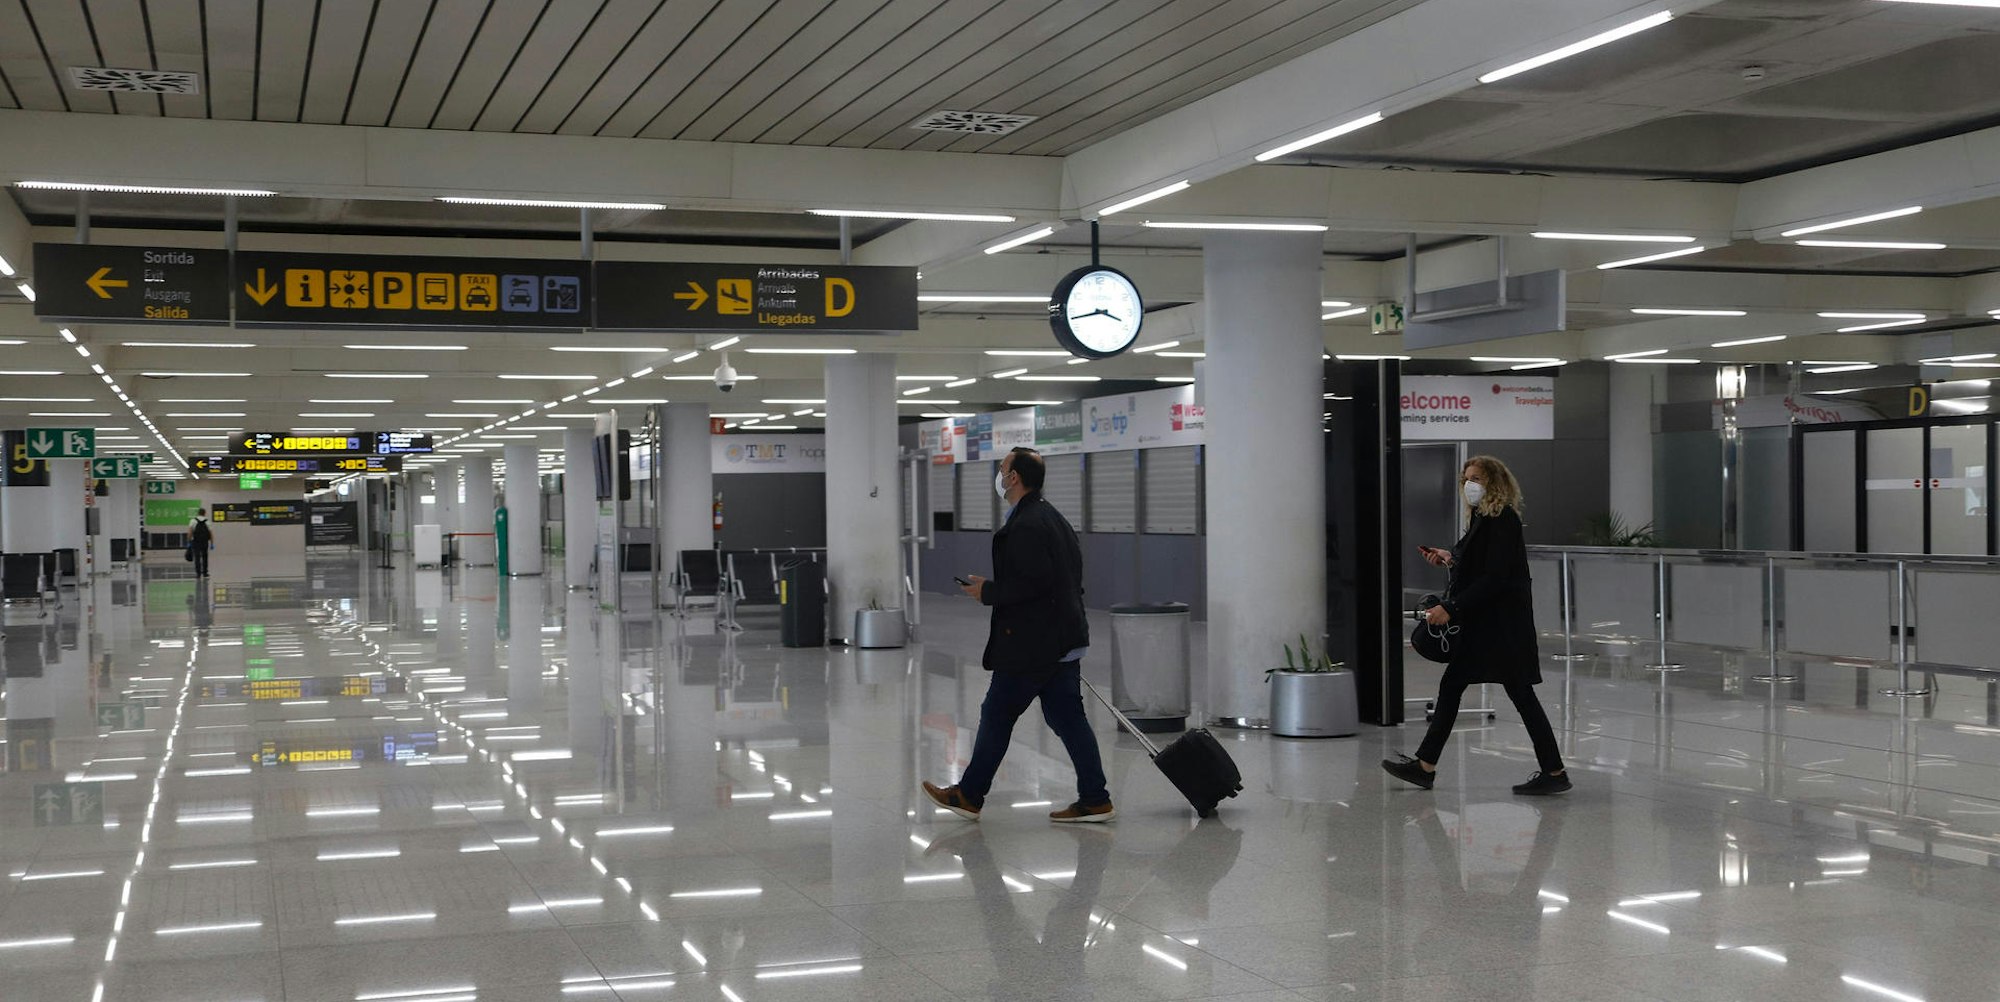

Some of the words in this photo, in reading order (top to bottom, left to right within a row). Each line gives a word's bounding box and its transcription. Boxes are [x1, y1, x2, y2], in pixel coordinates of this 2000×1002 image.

[144, 251, 194, 264] Sortida
[467, 276, 490, 284] TAXI
[758, 268, 820, 279] Arribades
[1095, 276, 1104, 285] 12
[144, 287, 191, 303] Ausgang
[383, 277, 404, 304] P
[758, 283, 796, 294] Arrivals
[824, 277, 855, 317] D
[144, 305, 189, 318] Salida
[758, 312, 816, 326] Llegadas
[1400, 391, 1471, 410] elcome
[1908, 386, 1927, 416] D
[1430, 414, 1469, 423] services
[745, 444, 786, 458] TMT
[13, 444, 35, 474] 5
